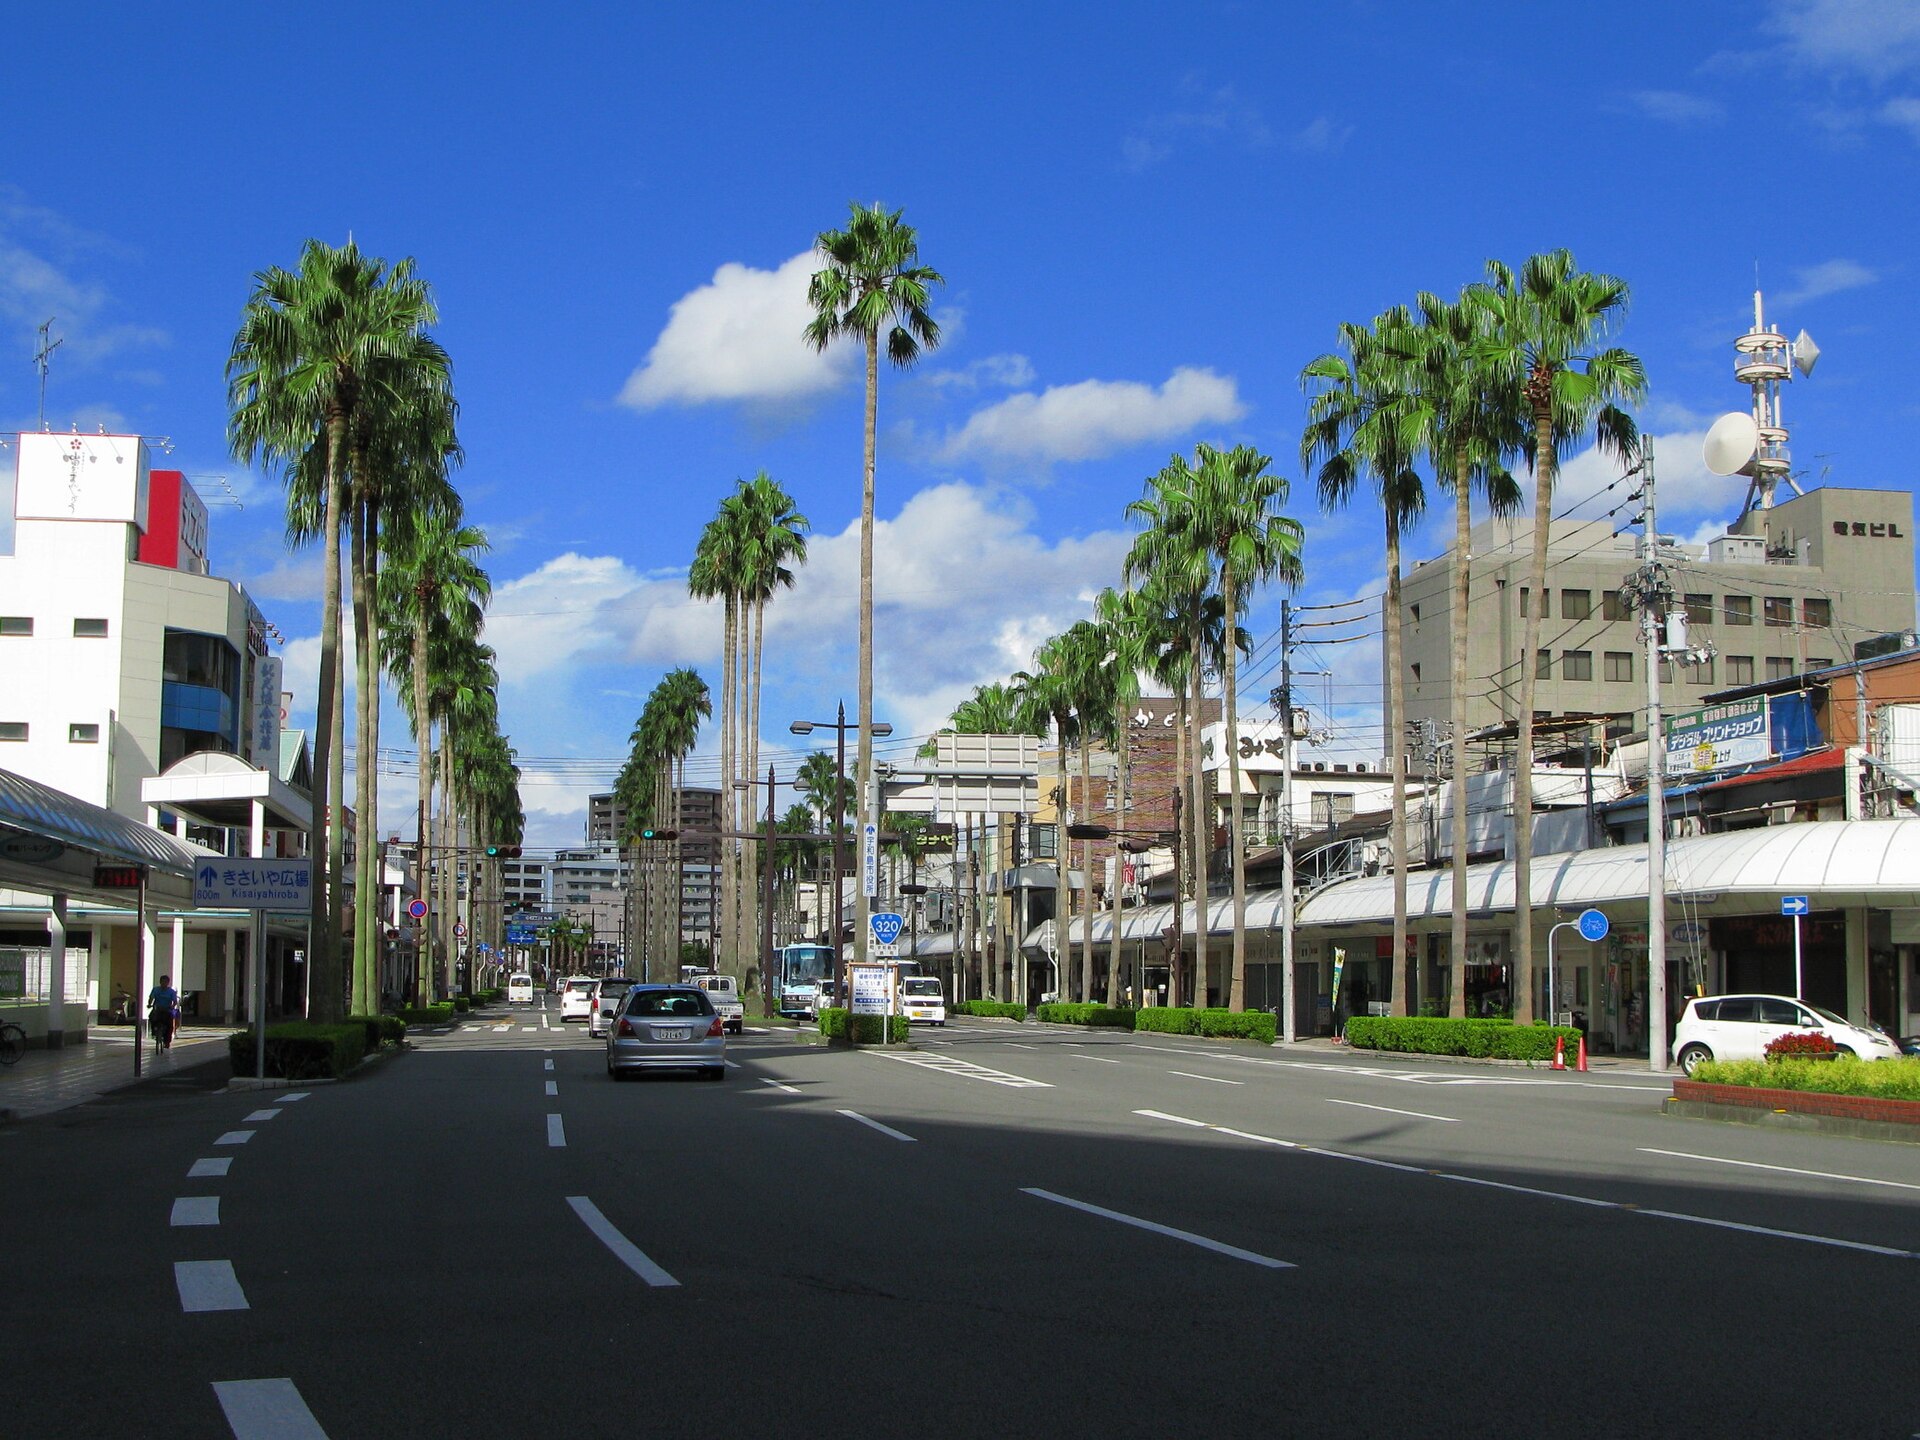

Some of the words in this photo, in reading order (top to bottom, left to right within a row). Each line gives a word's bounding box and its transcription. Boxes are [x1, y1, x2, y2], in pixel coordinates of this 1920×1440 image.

[866, 836, 875, 894] 宇和島市役所
[223, 869, 309, 887] きさいや広場
[231, 888, 299, 900] Kisaiyahiroba
[875, 921, 899, 933] 320
